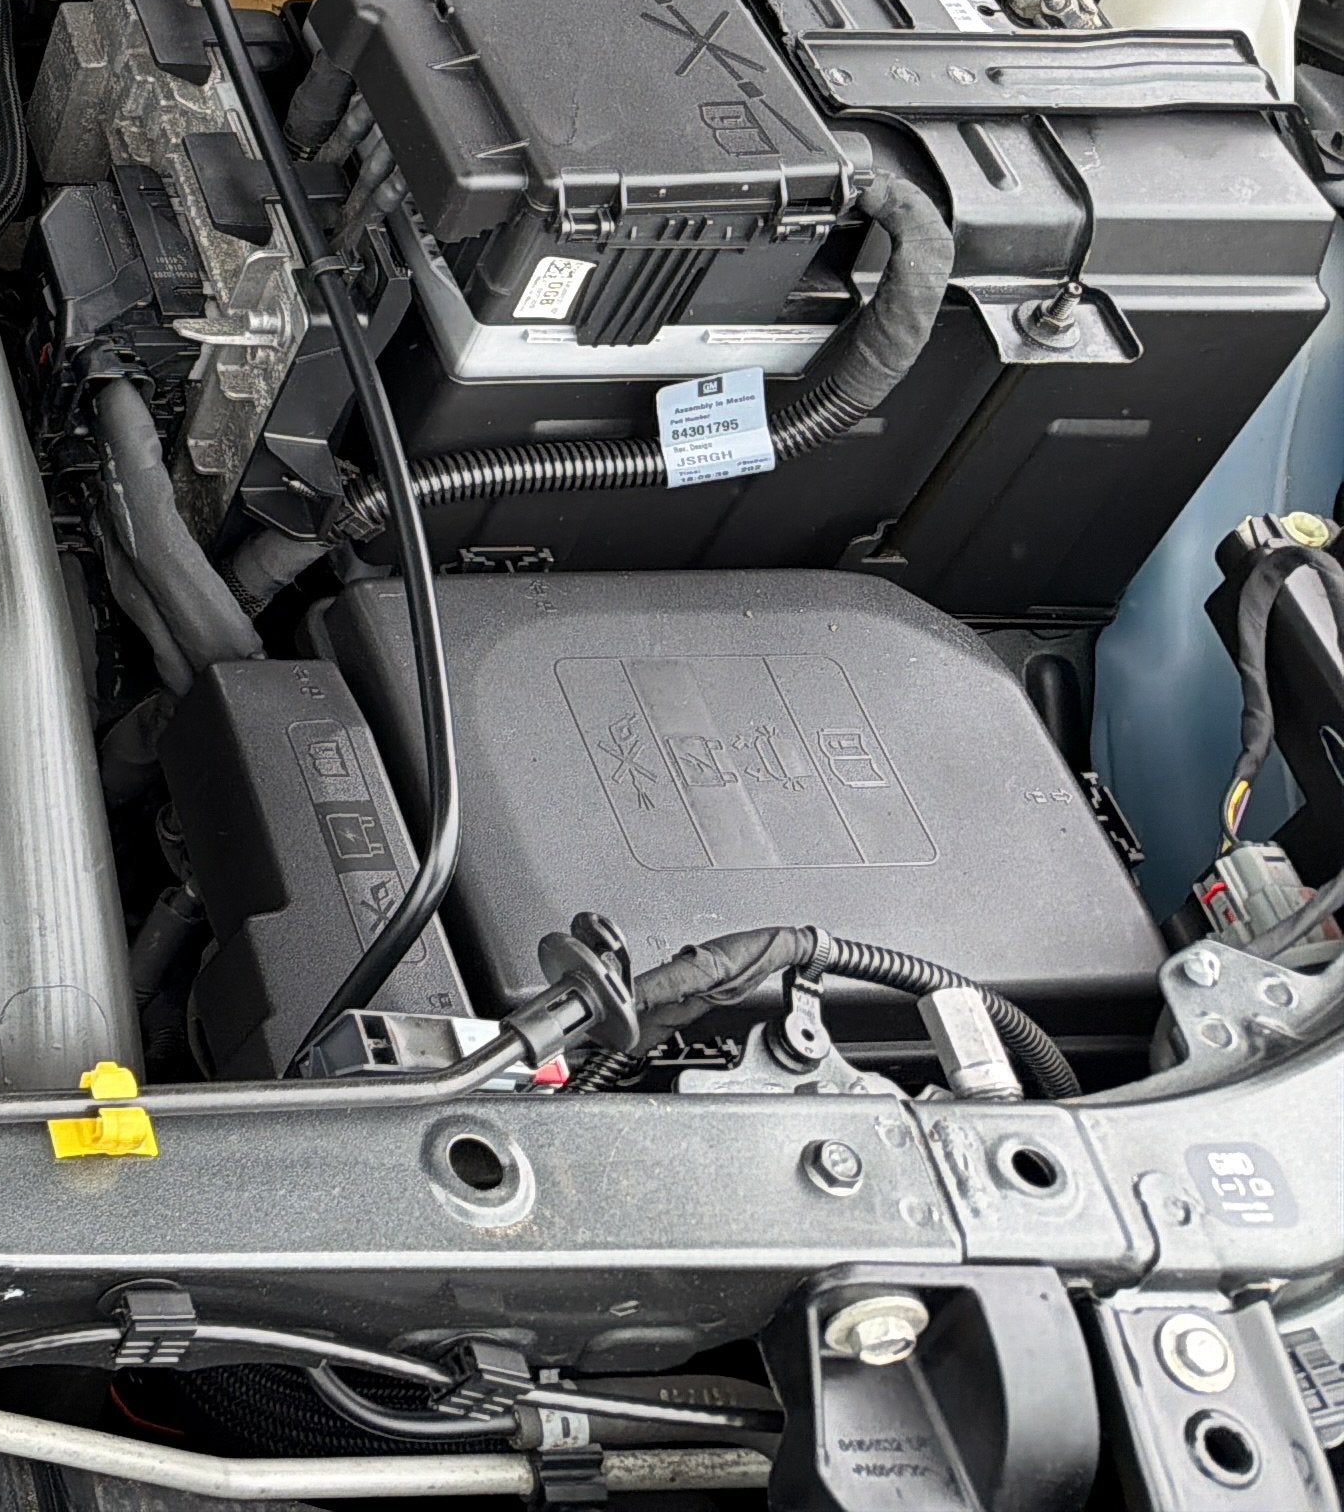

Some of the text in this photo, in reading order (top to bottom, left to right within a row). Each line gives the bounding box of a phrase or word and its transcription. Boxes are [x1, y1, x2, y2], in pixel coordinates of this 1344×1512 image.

[674, 402, 713, 414] Assembly
[726, 394, 756, 405] Mexico
[685, 413, 711, 423] Number
[671, 419, 739, 440] 84301795
